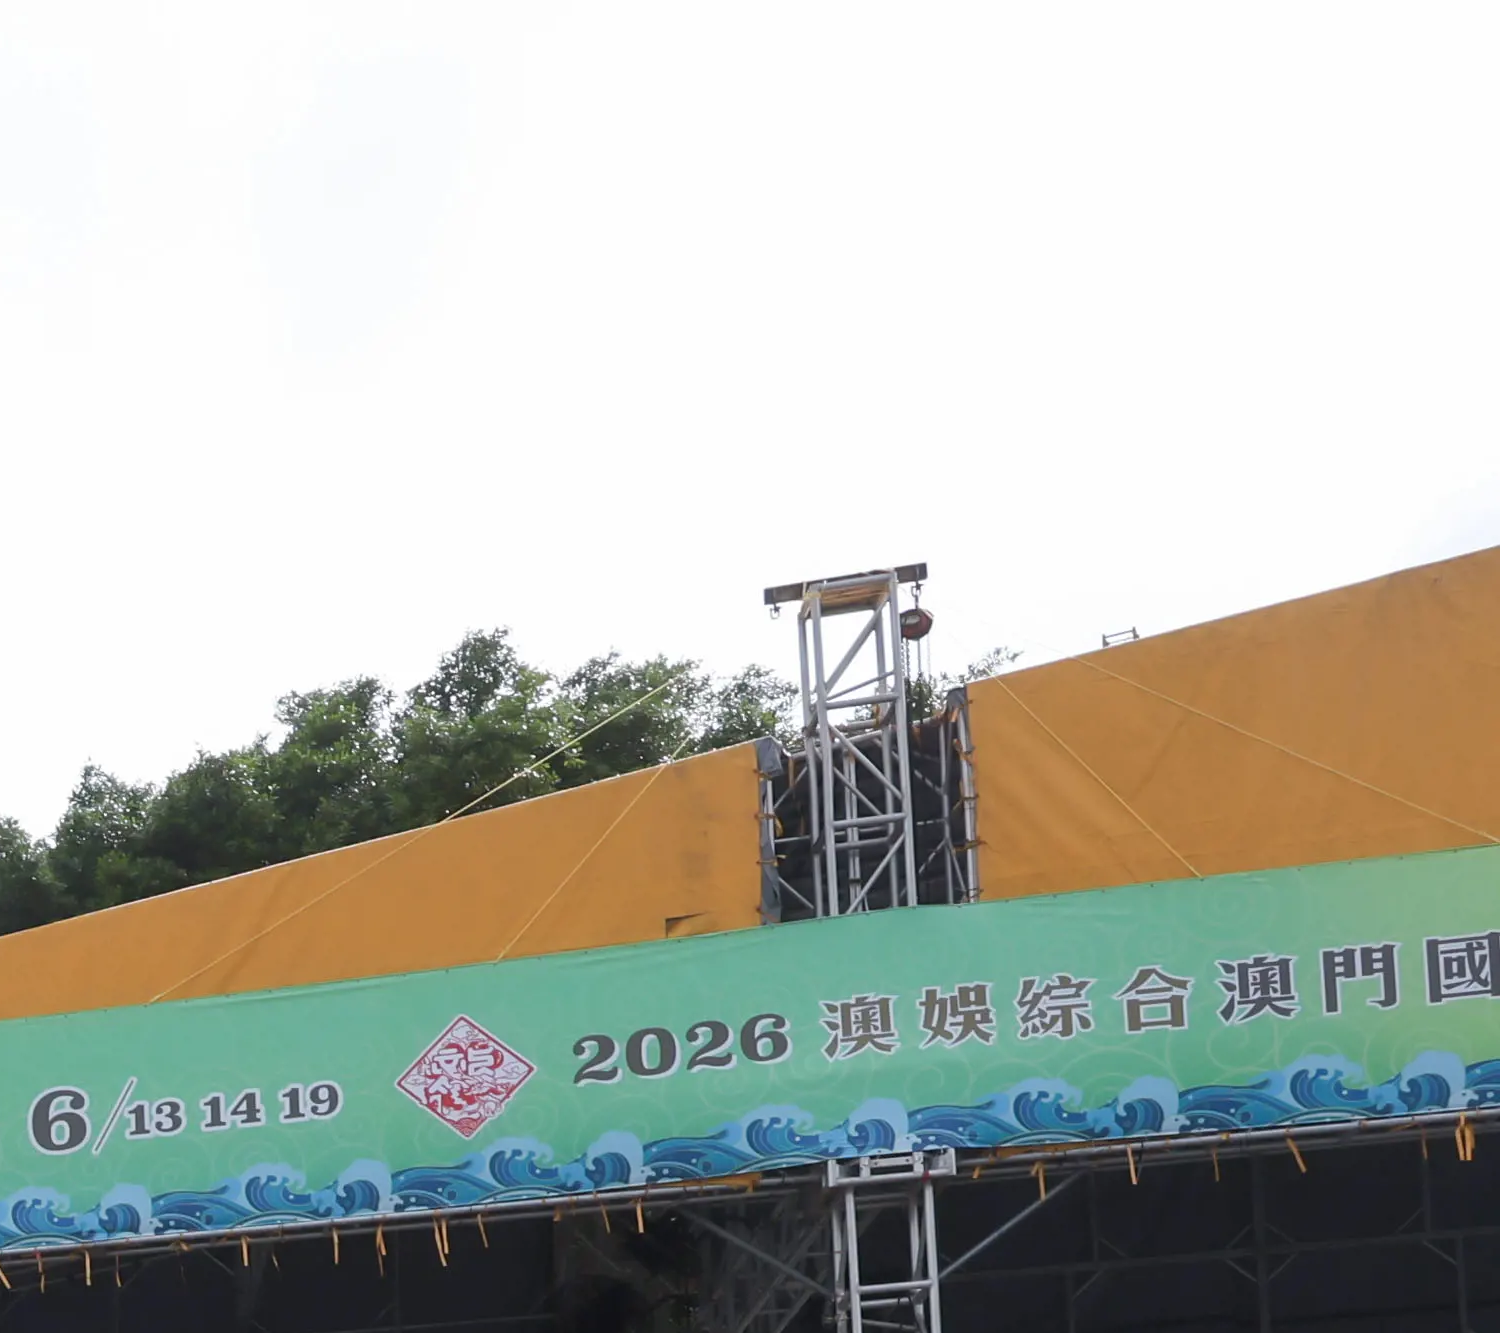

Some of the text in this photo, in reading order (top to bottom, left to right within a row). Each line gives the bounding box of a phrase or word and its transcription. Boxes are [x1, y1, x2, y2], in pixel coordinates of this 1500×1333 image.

[572, 1012, 791, 1087] 2026
[200, 1090, 265, 1131] 14
[279, 1080, 343, 1122] 19
